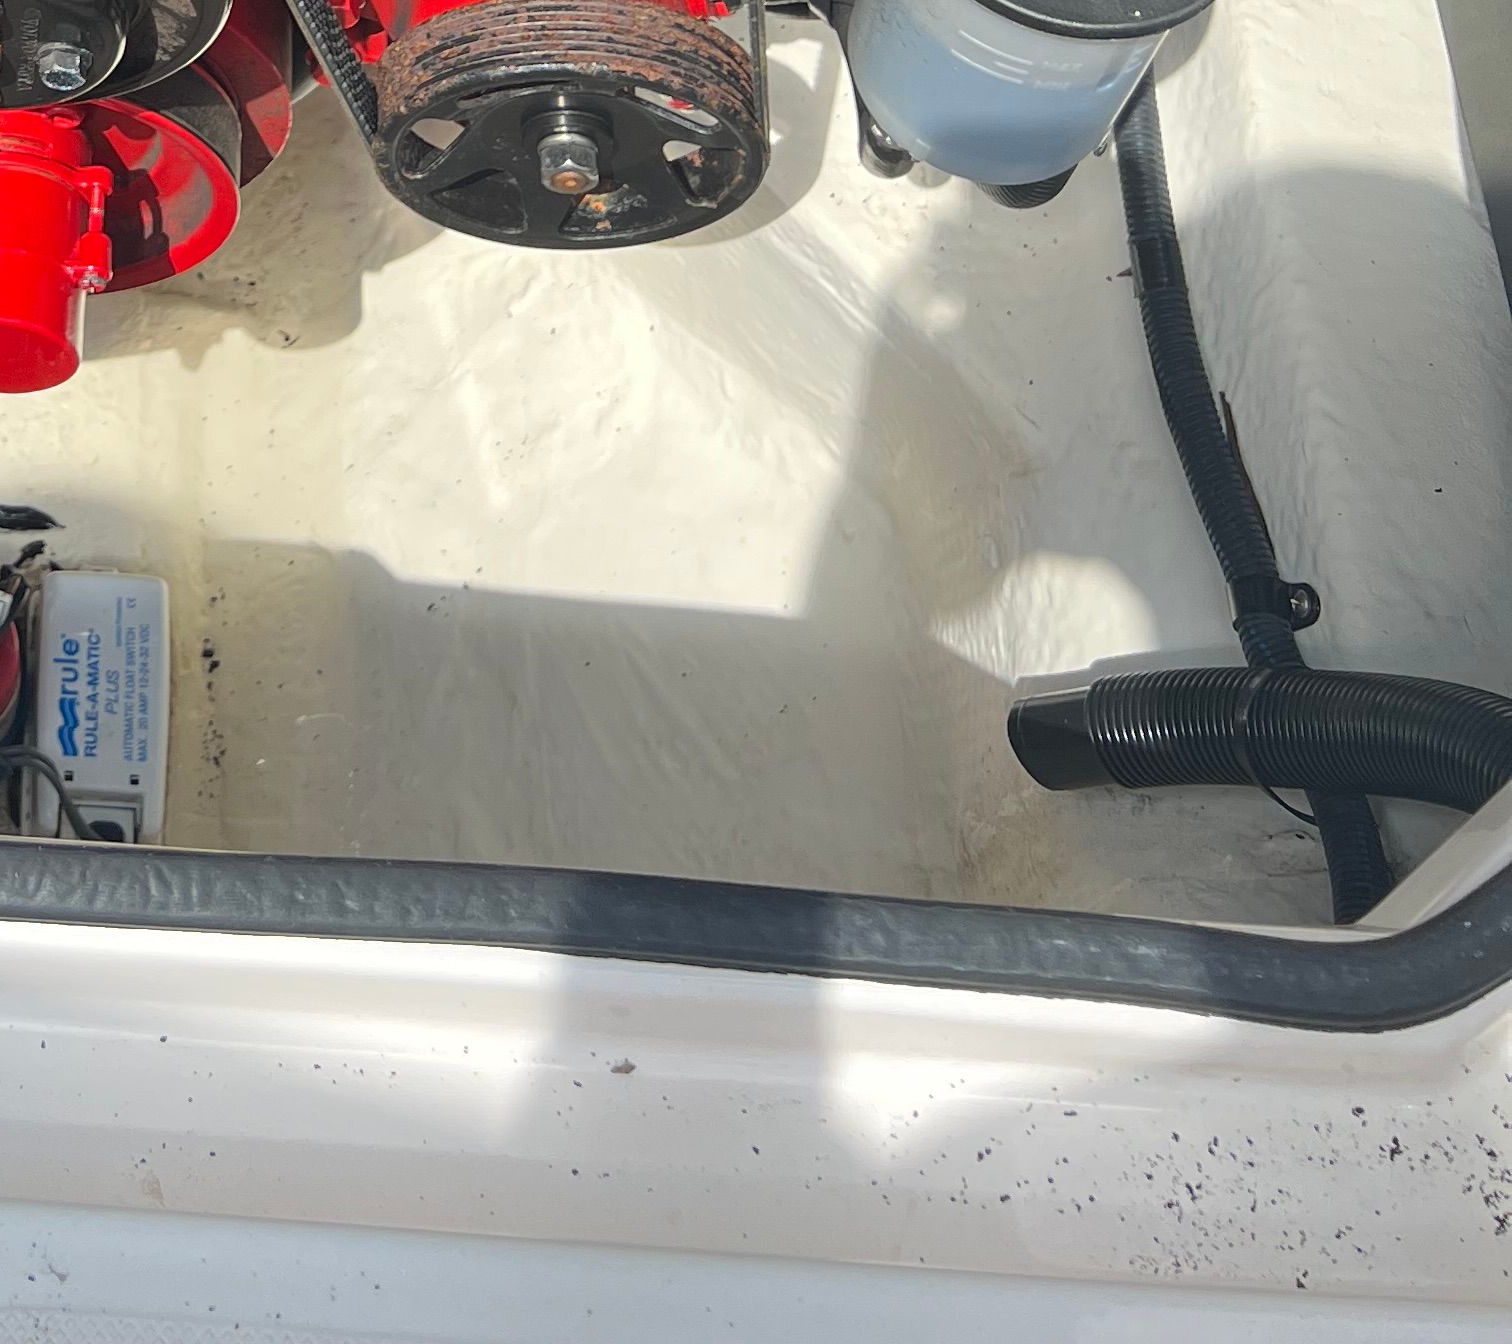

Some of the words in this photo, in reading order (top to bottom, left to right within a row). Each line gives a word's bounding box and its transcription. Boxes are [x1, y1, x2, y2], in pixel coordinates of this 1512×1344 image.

[53, 638, 80, 696] rule
[84, 633, 101, 757] RULE-A-MATIC
[104, 669, 120, 715] PLUS
